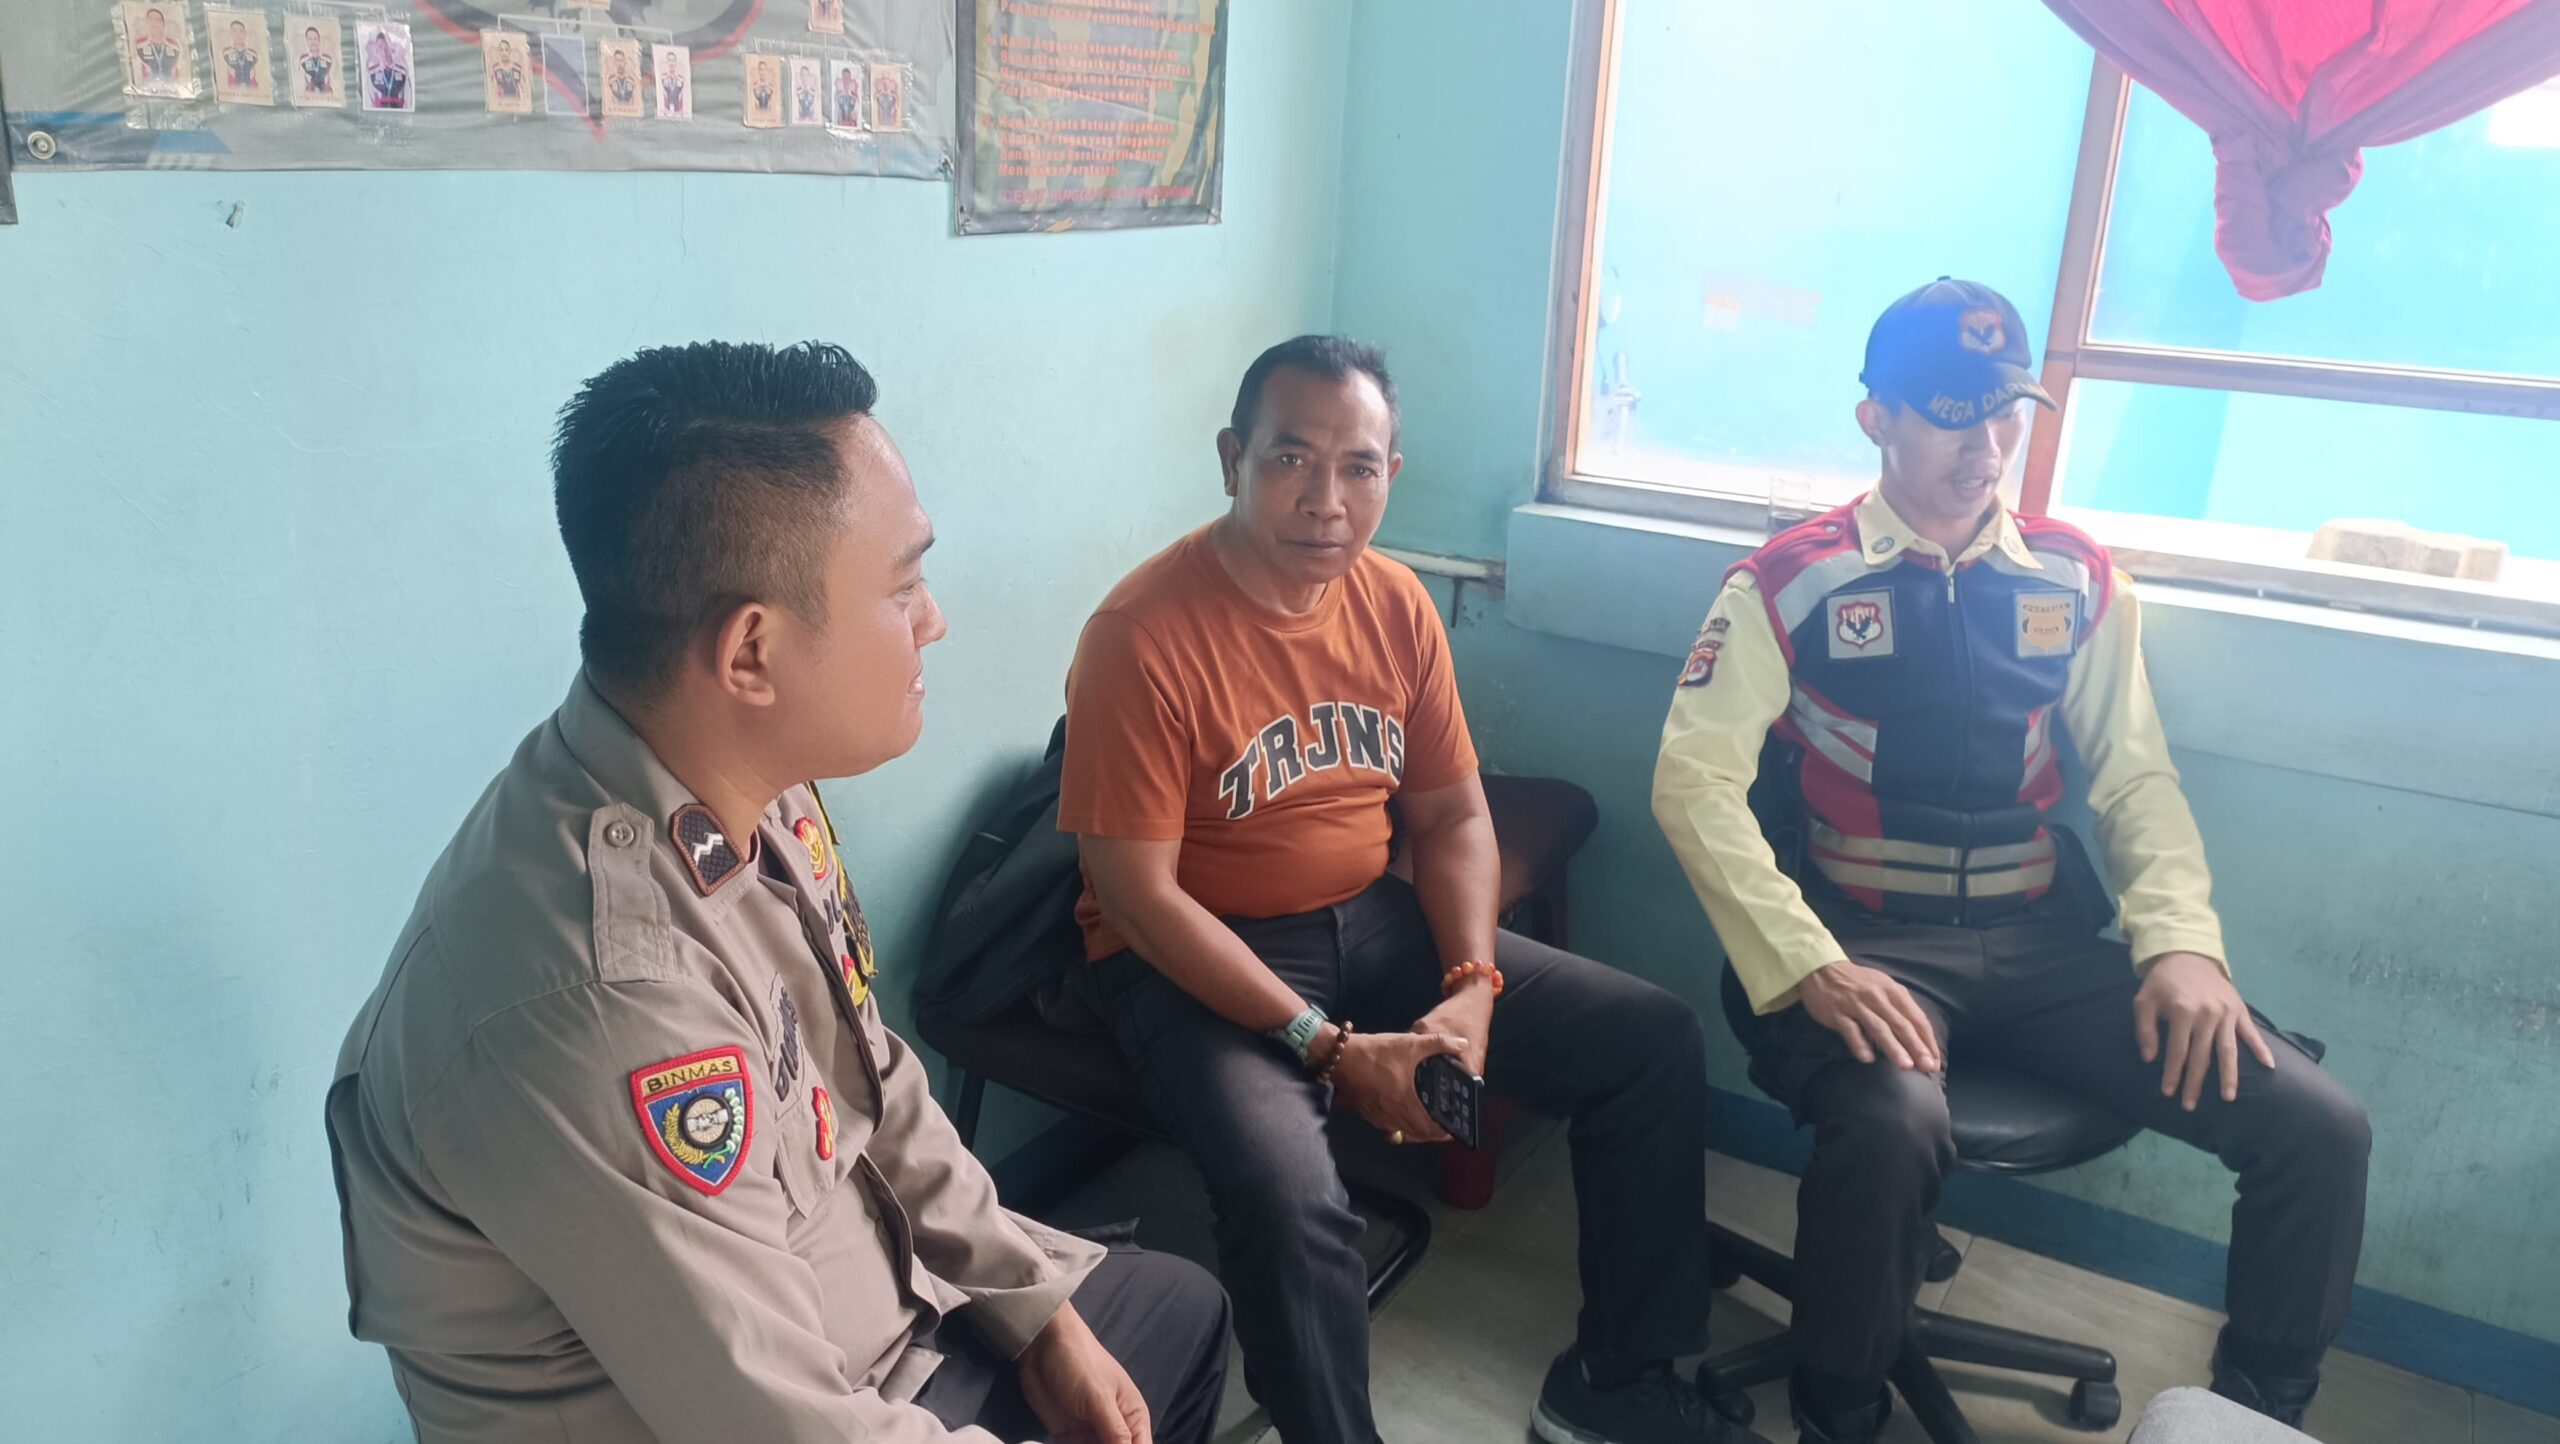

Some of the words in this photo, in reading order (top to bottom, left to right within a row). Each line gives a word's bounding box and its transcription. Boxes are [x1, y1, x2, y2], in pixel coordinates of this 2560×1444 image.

[1928, 393, 1975, 422] MEGA
[1218, 701, 1404, 820] TRJNS
[647, 1060, 733, 1093] BINMAS
